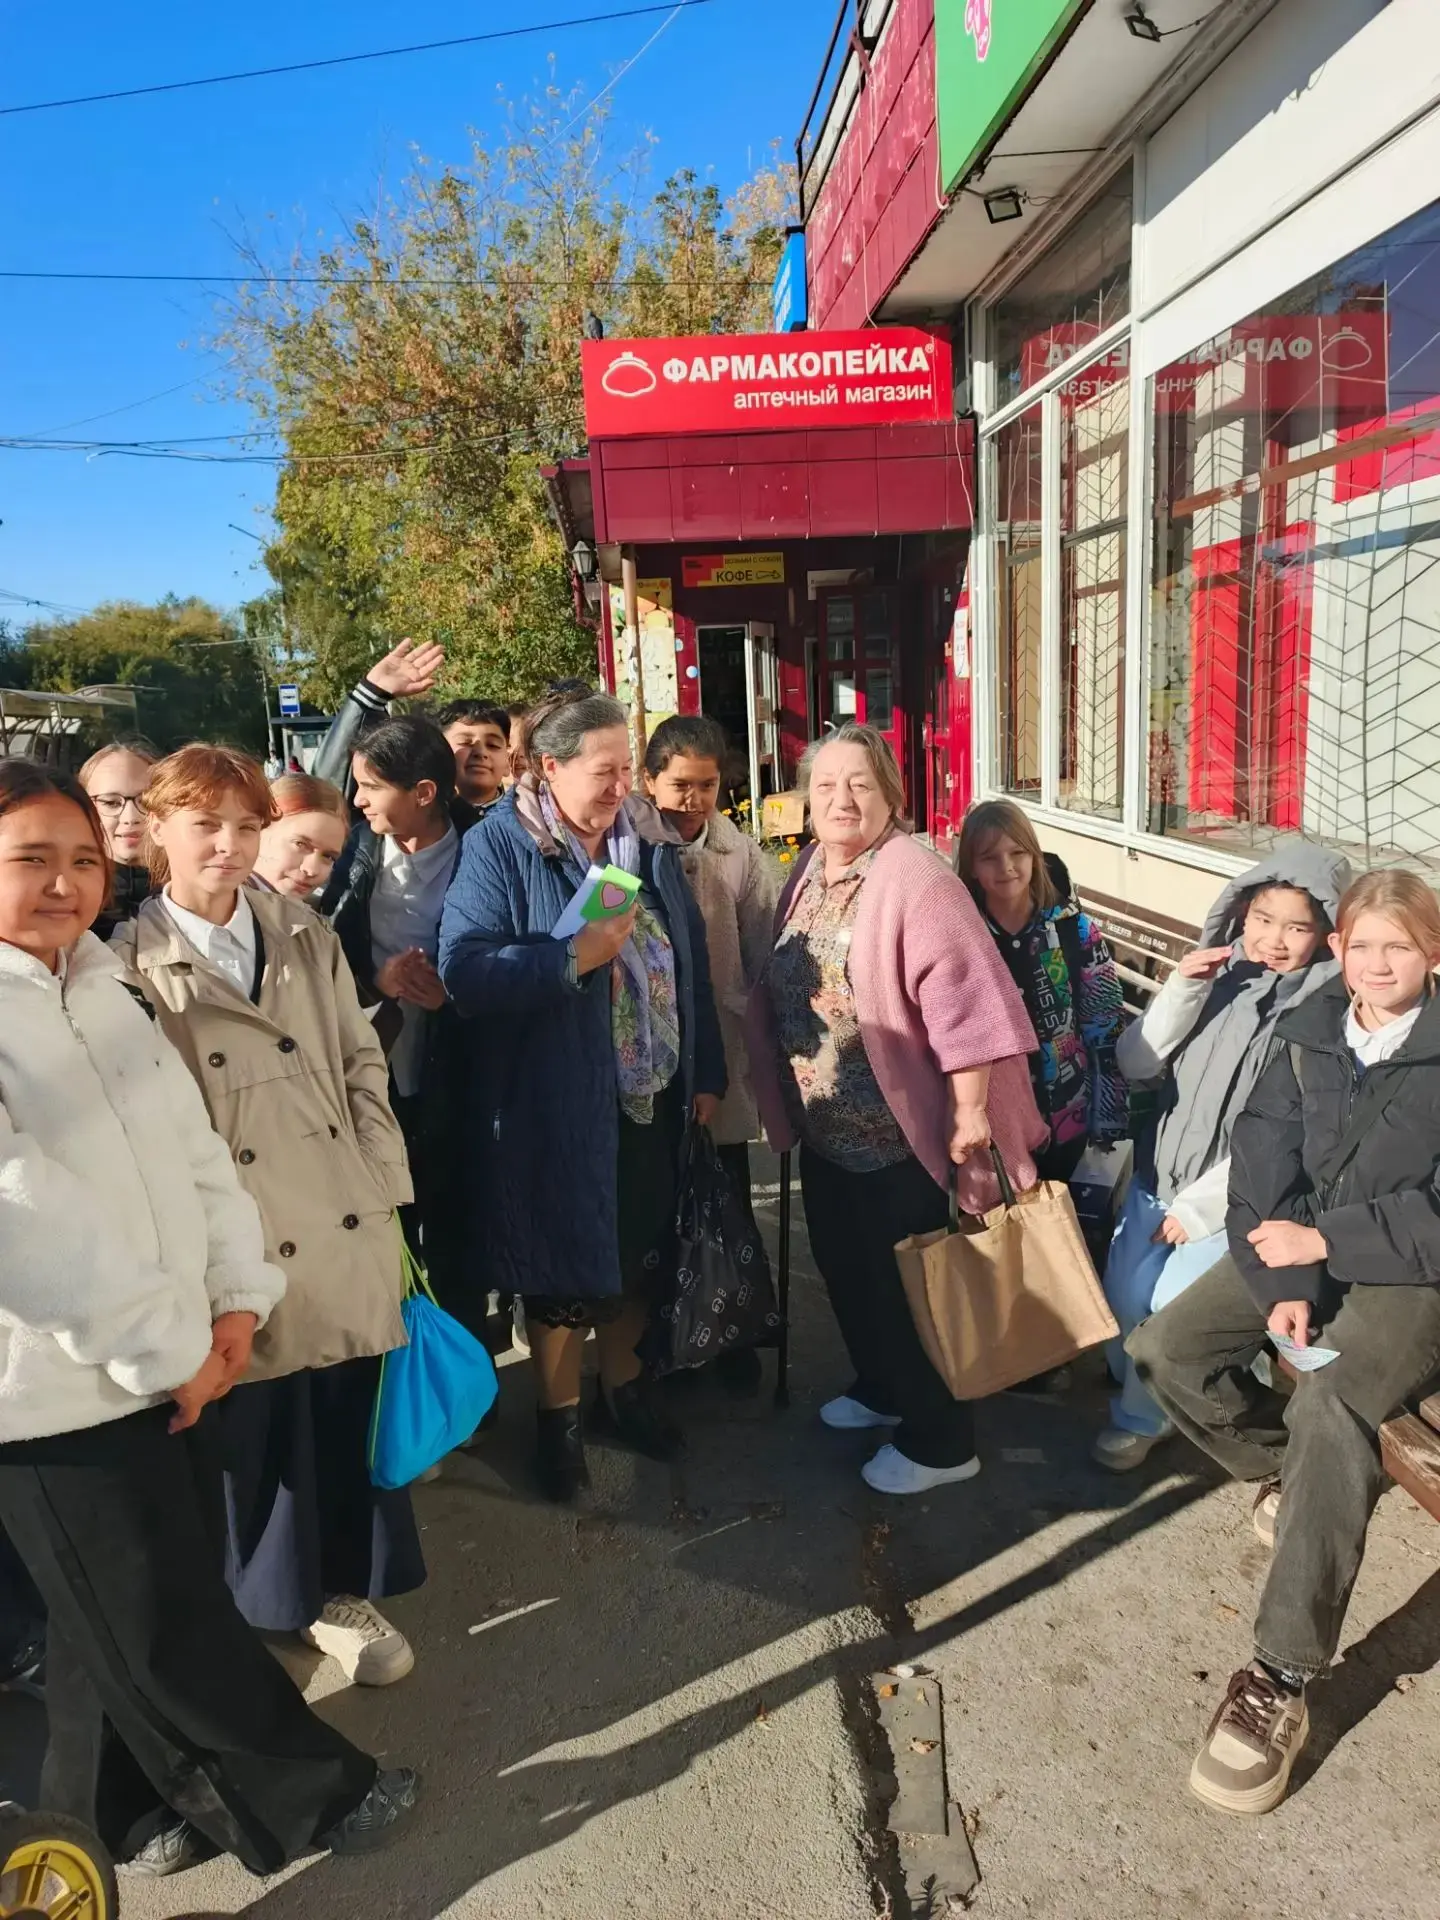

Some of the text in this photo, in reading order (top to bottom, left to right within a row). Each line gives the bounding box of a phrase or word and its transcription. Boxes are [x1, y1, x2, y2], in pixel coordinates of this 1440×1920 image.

[662, 343, 930, 383] ФАРМАКОПЕЙКА
[733, 383, 932, 409] аптечный магазин
[716, 569, 753, 583] КОФЕ
[1033, 964, 1055, 1008] THIS
[1044, 1009, 1060, 1030] IS
